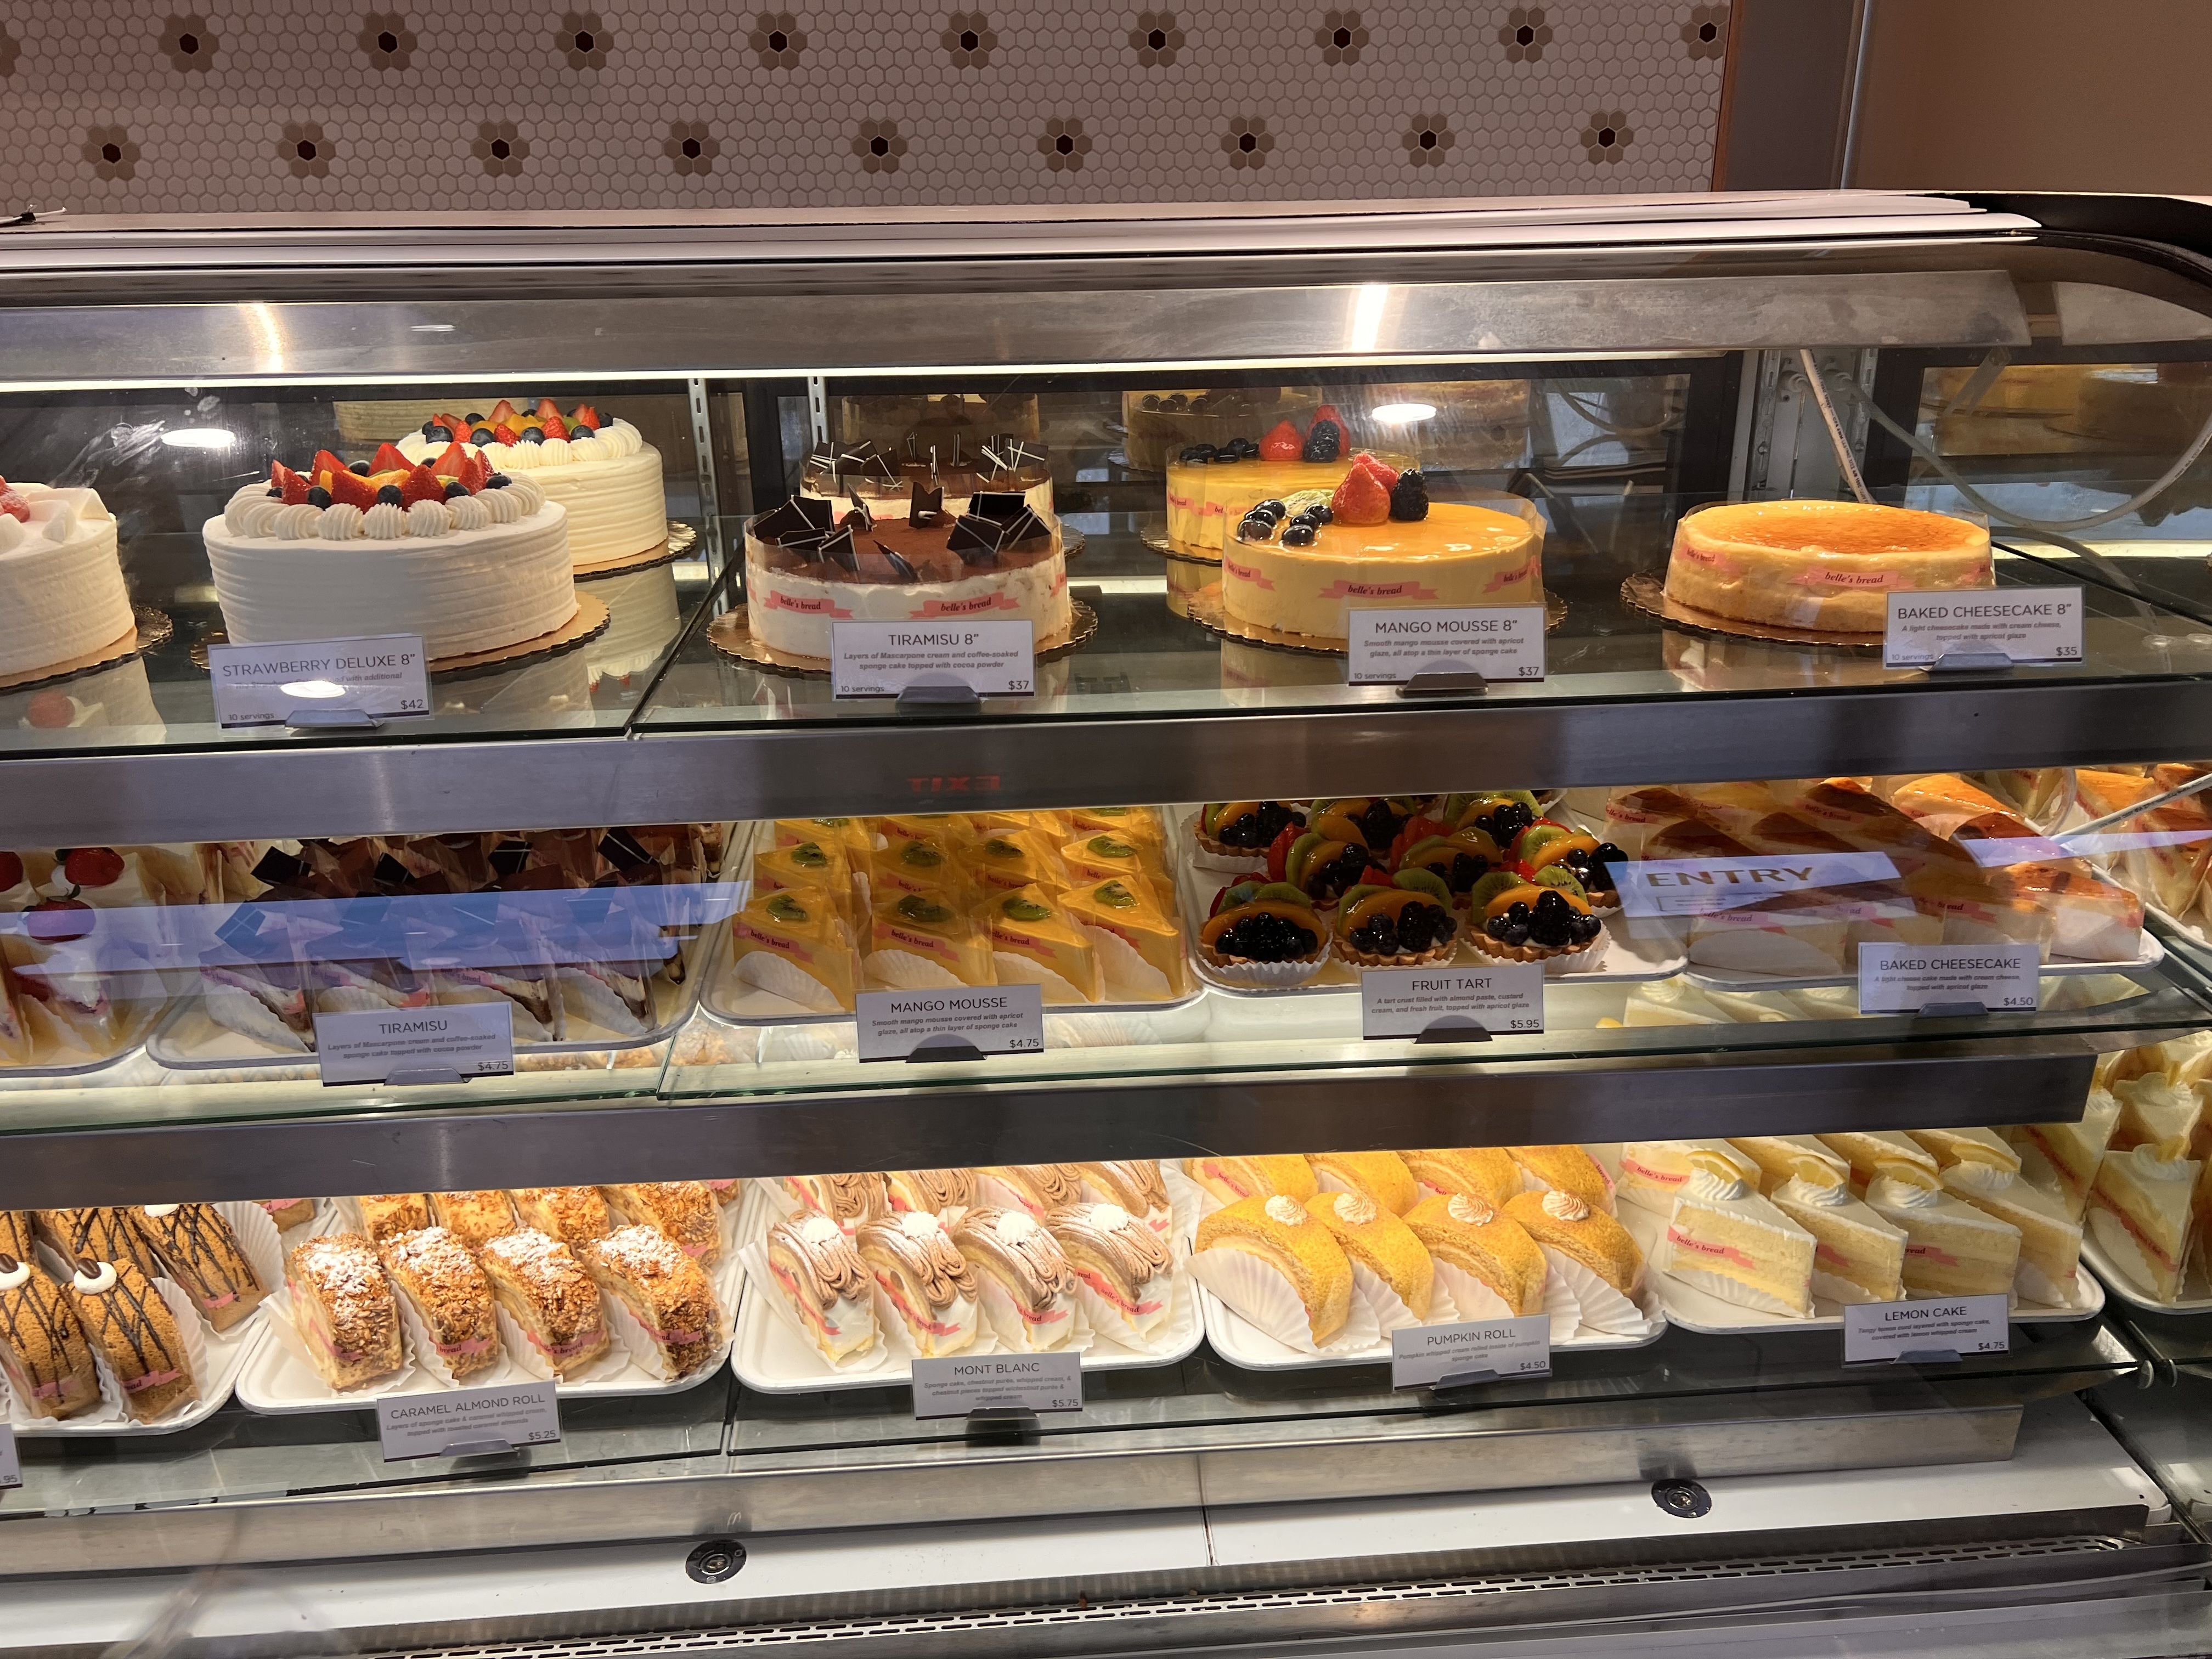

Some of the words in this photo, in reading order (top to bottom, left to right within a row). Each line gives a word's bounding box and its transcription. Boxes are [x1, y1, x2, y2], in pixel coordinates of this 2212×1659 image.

[1825, 572, 1854, 584] belle's
[1856, 574, 1884, 584] bread
[1347, 585, 1374, 595] belle's
[1376, 585, 1402, 595] bread
[780, 596, 799, 609] belle's
[801, 601, 821, 611] bread
[941, 601, 966, 612] belle's
[969, 598, 992, 610] bread
[1898, 607, 1949, 619] BAKED
[1953, 603, 2052, 618] CHEESECAKE
[1375, 621, 1432, 634] MANGO
[1437, 620, 1499, 633] MOUSSE
[888, 634, 960, 646] TIRAMISU
[843, 652, 870, 661] Layers
[879, 652, 926, 661] Mascarpone
[967, 650, 1019, 658] coffee-soaked
[2056, 646, 2078, 657] $35
[222, 658, 330, 677] STRAWBERRY
[335, 654, 396, 669] DELUXE
[907, 662, 934, 670] topped
[976, 661, 1005, 670] powder
[1518, 666, 1539, 677] $37
[345, 674, 363, 684] with
[364, 672, 403, 681] additional
[1008, 680, 1029, 691] $37
[400, 699, 424, 710] $42
[239, 712, 274, 721] servings
[1625, 812, 1646, 823] bread
[1646, 867, 1814, 887] ENTRY
[1726, 913, 1752, 923] bread
[751, 930, 770, 944] belle's
[771, 936, 790, 949] bread
[891, 929, 912, 943] belle's
[913, 935, 934, 948] bread
[1009, 934, 1030, 946] bread
[1880, 960, 1927, 970] BAKED
[1931, 958, 2021, 970] CHEESECAKE
[1412, 979, 1452, 991] FRUIT
[1455, 978, 1492, 989] TART
[891, 1000, 945, 1013] MANGO
[950, 997, 1008, 1010] MOUSSE
[2004, 997, 2034, 1006] $4.50
[1371, 1005, 1396, 1014] cream,
[1446, 1003, 1470, 1012] topped
[1486, 1002, 1510, 1011] apricot
[1511, 1002, 1530, 1010] glaze
[872, 1018, 899, 1027] Smooth
[999, 1012, 1023, 1021] apricot
[1510, 1019, 1539, 1029] $5.95
[378, 1020, 448, 1034] TIRAMISU
[877, 1029, 898, 1037] glaze,
[1009, 1038, 1039, 1049] $4.75
[478, 1061, 509, 1071] $4.75
[1637, 1166, 1658, 1180] belle's
[1660, 1173, 1683, 1183] bread
[1676, 1235, 1700, 1250] belle's
[1701, 1242, 1725, 1255] bread
[1120, 1298, 1140, 1313] bread
[1023, 1311, 1042, 1322] bread
[1884, 1309, 1929, 1321] LEMON
[1933, 1306, 1967, 1317] CAKE
[1427, 1331, 1481, 1346] PUMPKIN
[1484, 1329, 1516, 1340] ROLL
[439, 1344, 462, 1353] bread
[559, 1340, 584, 1355] bread
[1978, 1342, 2005, 1350] $4.75
[954, 1364, 992, 1376] MONT
[996, 1362, 1040, 1373] BLANC
[1520, 1361, 1546, 1370] $4.50
[390, 1404, 452, 1419] CARAMEL
[455, 1397, 509, 1412] ALMOND
[512, 1393, 545, 1406] ROLL
[1052, 1399, 1079, 1407] $5.75
[528, 1430, 556, 1441] $5.25
